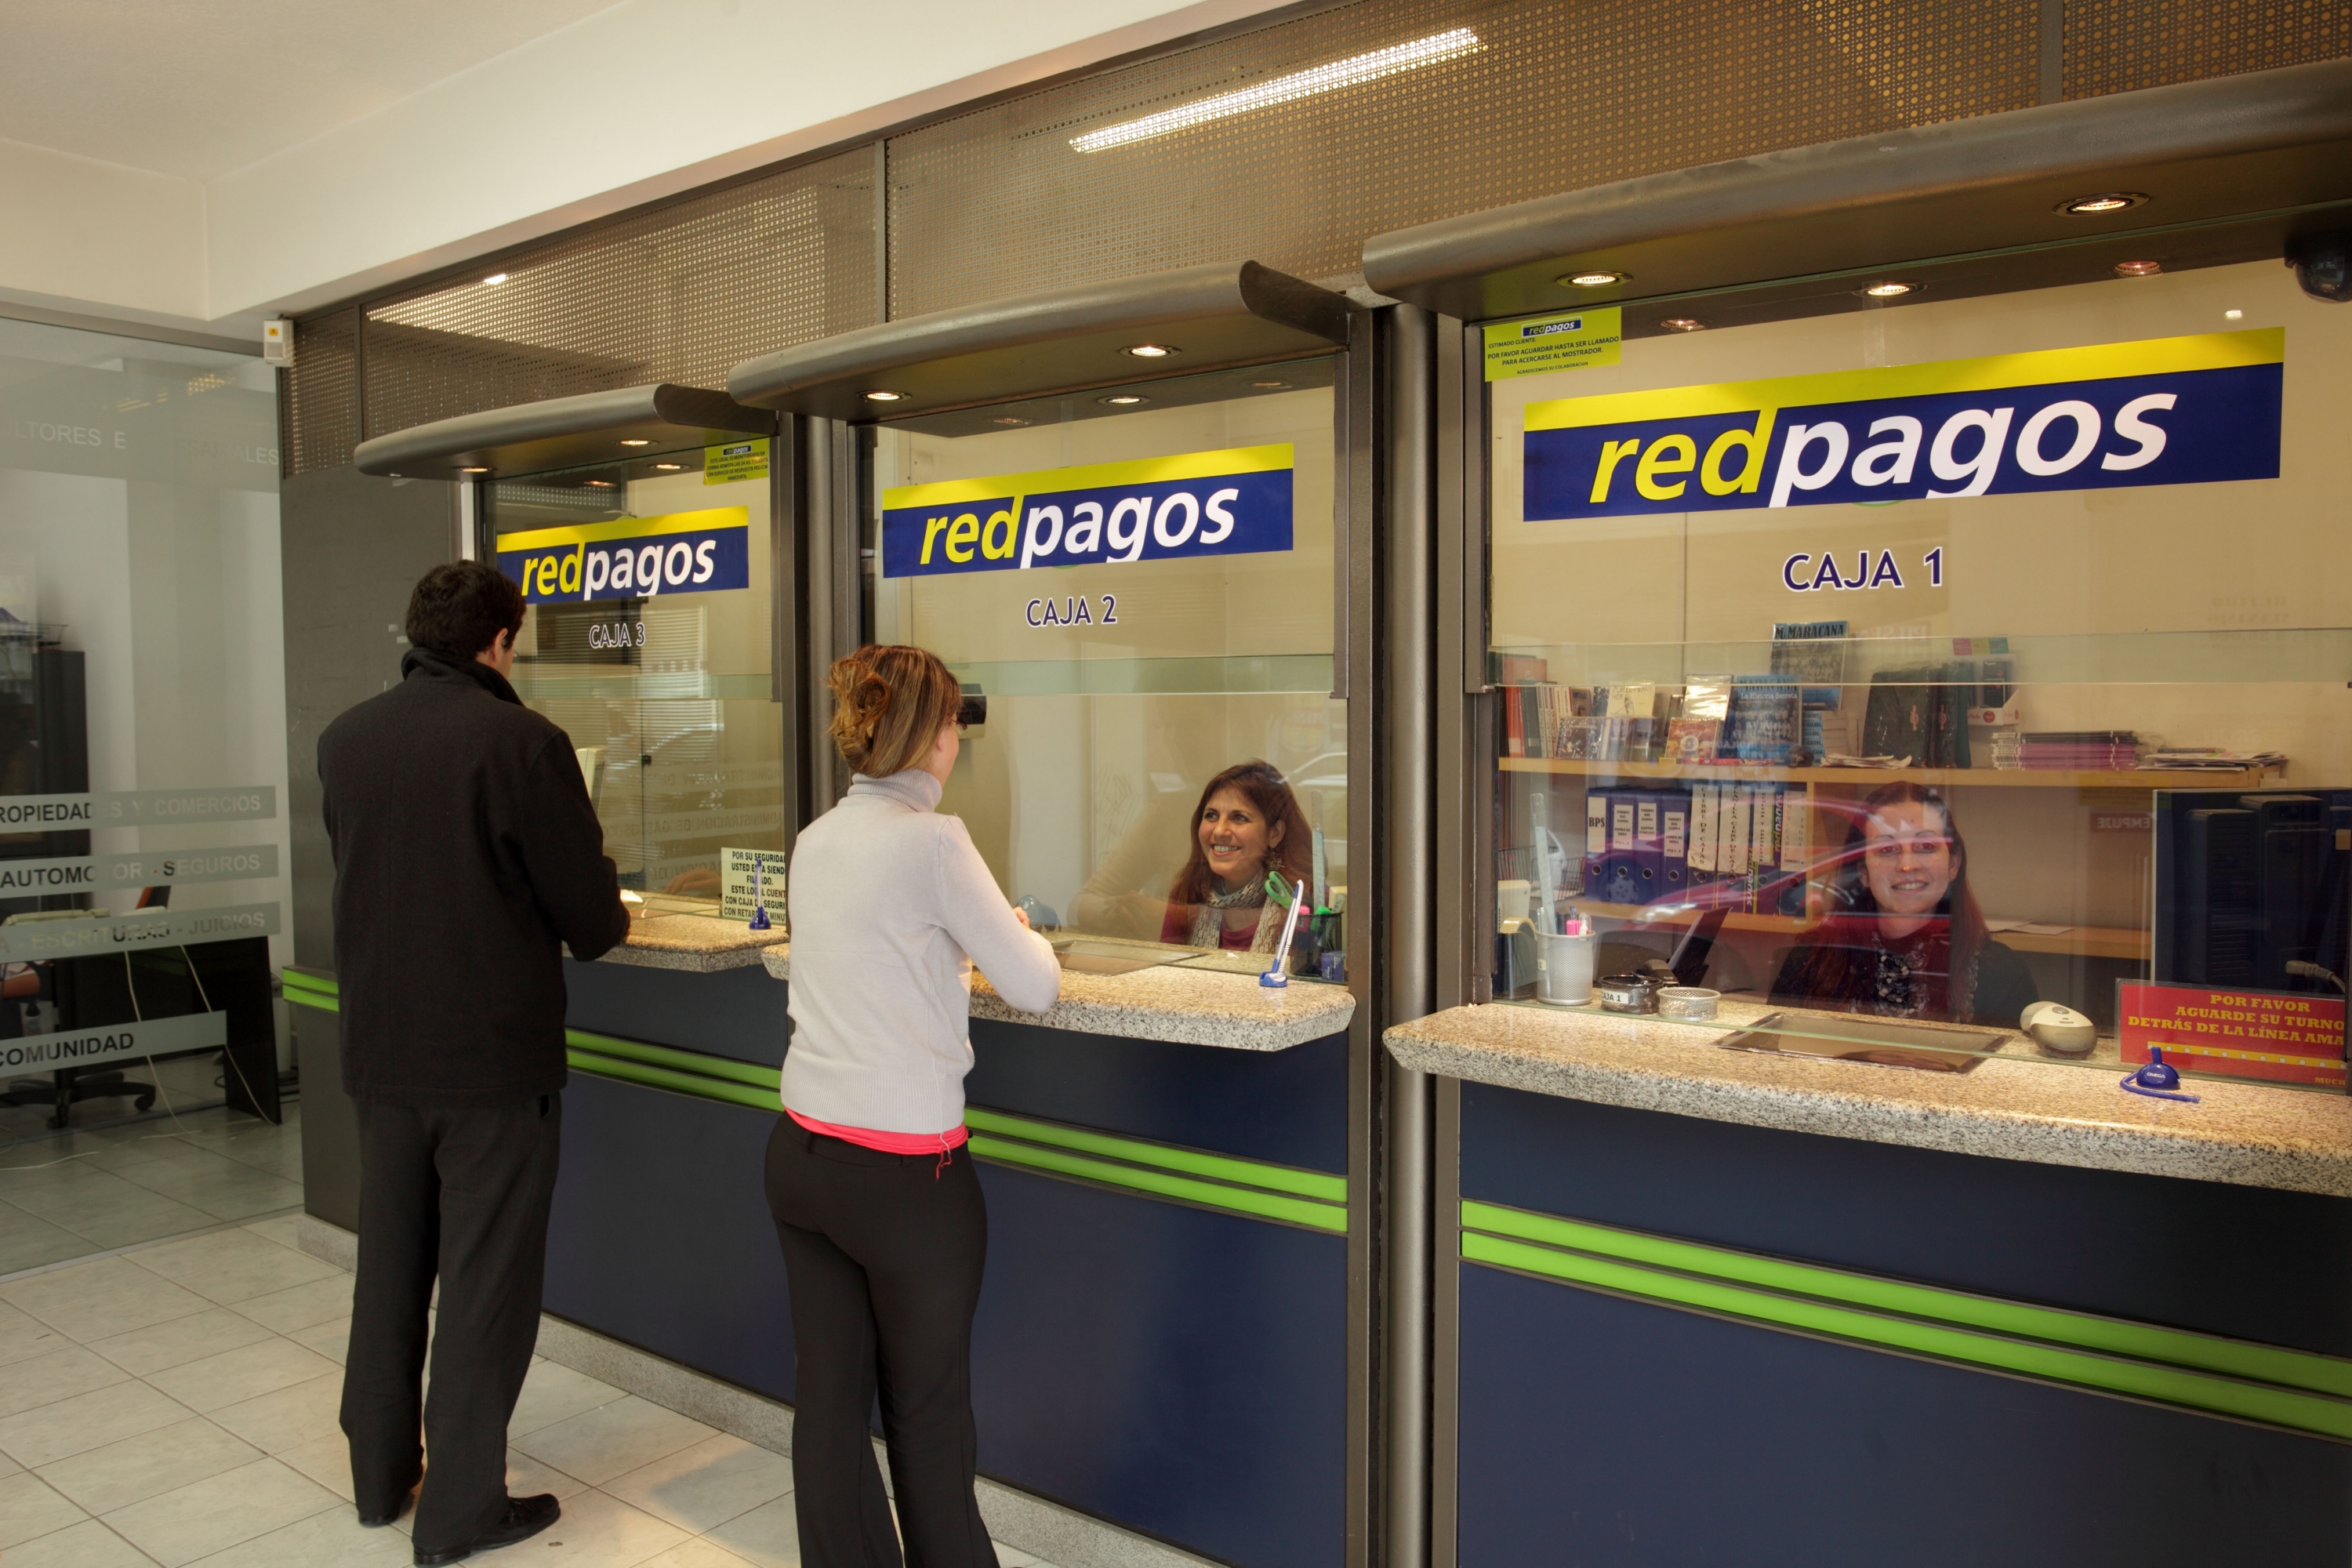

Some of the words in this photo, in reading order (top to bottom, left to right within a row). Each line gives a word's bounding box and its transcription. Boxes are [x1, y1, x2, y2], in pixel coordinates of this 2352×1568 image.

[1529, 321, 1575, 335] redpagos
[1488, 339, 1515, 349] ESTIMADO
[1501, 350, 1520, 358] FAVOR
[1520, 345, 1554, 356] AGUARDAR
[1554, 342, 1574, 350] HASTA
[1588, 336, 1620, 346] LLAMADO
[1518, 354, 1552, 364] ACERCARSE
[1562, 347, 1603, 358] MOSTRADOR.
[1516, 366, 1548, 375] AGRADECEMOS
[114, 430, 127, 449] E
[1588, 392, 2176, 508] redpagos
[920, 488, 1240, 569] redpagos
[521, 539, 717, 601] redpagos
[1782, 548, 1903, 592] CAJA
[1922, 546, 1944, 588] 1
[1025, 595, 1092, 627] CAJA
[1101, 593, 1118, 626] 2
[589, 624, 632, 648] CAJA
[636, 622, 646, 647] 3
[156, 794, 261, 816] COMERCIOS
[1588, 817, 1606, 828] BPS
[163, 855, 260, 877] SEGUROS
[732, 851, 744, 860] POR
[746, 852, 753, 861] SU
[754, 853, 785, 863] SEGURIDA
[731, 862, 750, 872] USTED
[751, 864, 766, 873] EA
[767, 866, 785, 875] SIEND
[746, 875, 774, 886] FILDO.
[731, 885, 746, 895] ESTE
[747, 887, 765, 896] LOL
[725, 896, 737, 905] CON
[738, 897, 753, 906] CAJA
[724, 907, 736, 916] CON
[737, 909, 758, 918] RETARD
[770, 913, 786, 922] MINU
[31, 922, 170, 950] ESCRITURAS
[188, 912, 265, 935] JUICIOS
[2210, 994, 2247, 1007] POR
[2251, 998, 2310, 1013] FAVOR
[2176, 1006, 2256, 1023] AGUARDE
[2260, 1013, 2281, 1025] SU
[2285, 1015, 2345, 1031] TURNO
[2128, 1015, 2193, 1031] DETRÁS
[2196, 1022, 2220, 1034] DE
[2223, 1025, 2245, 1036] LA
[2249, 1025, 2301, 1042] LÍNEA
